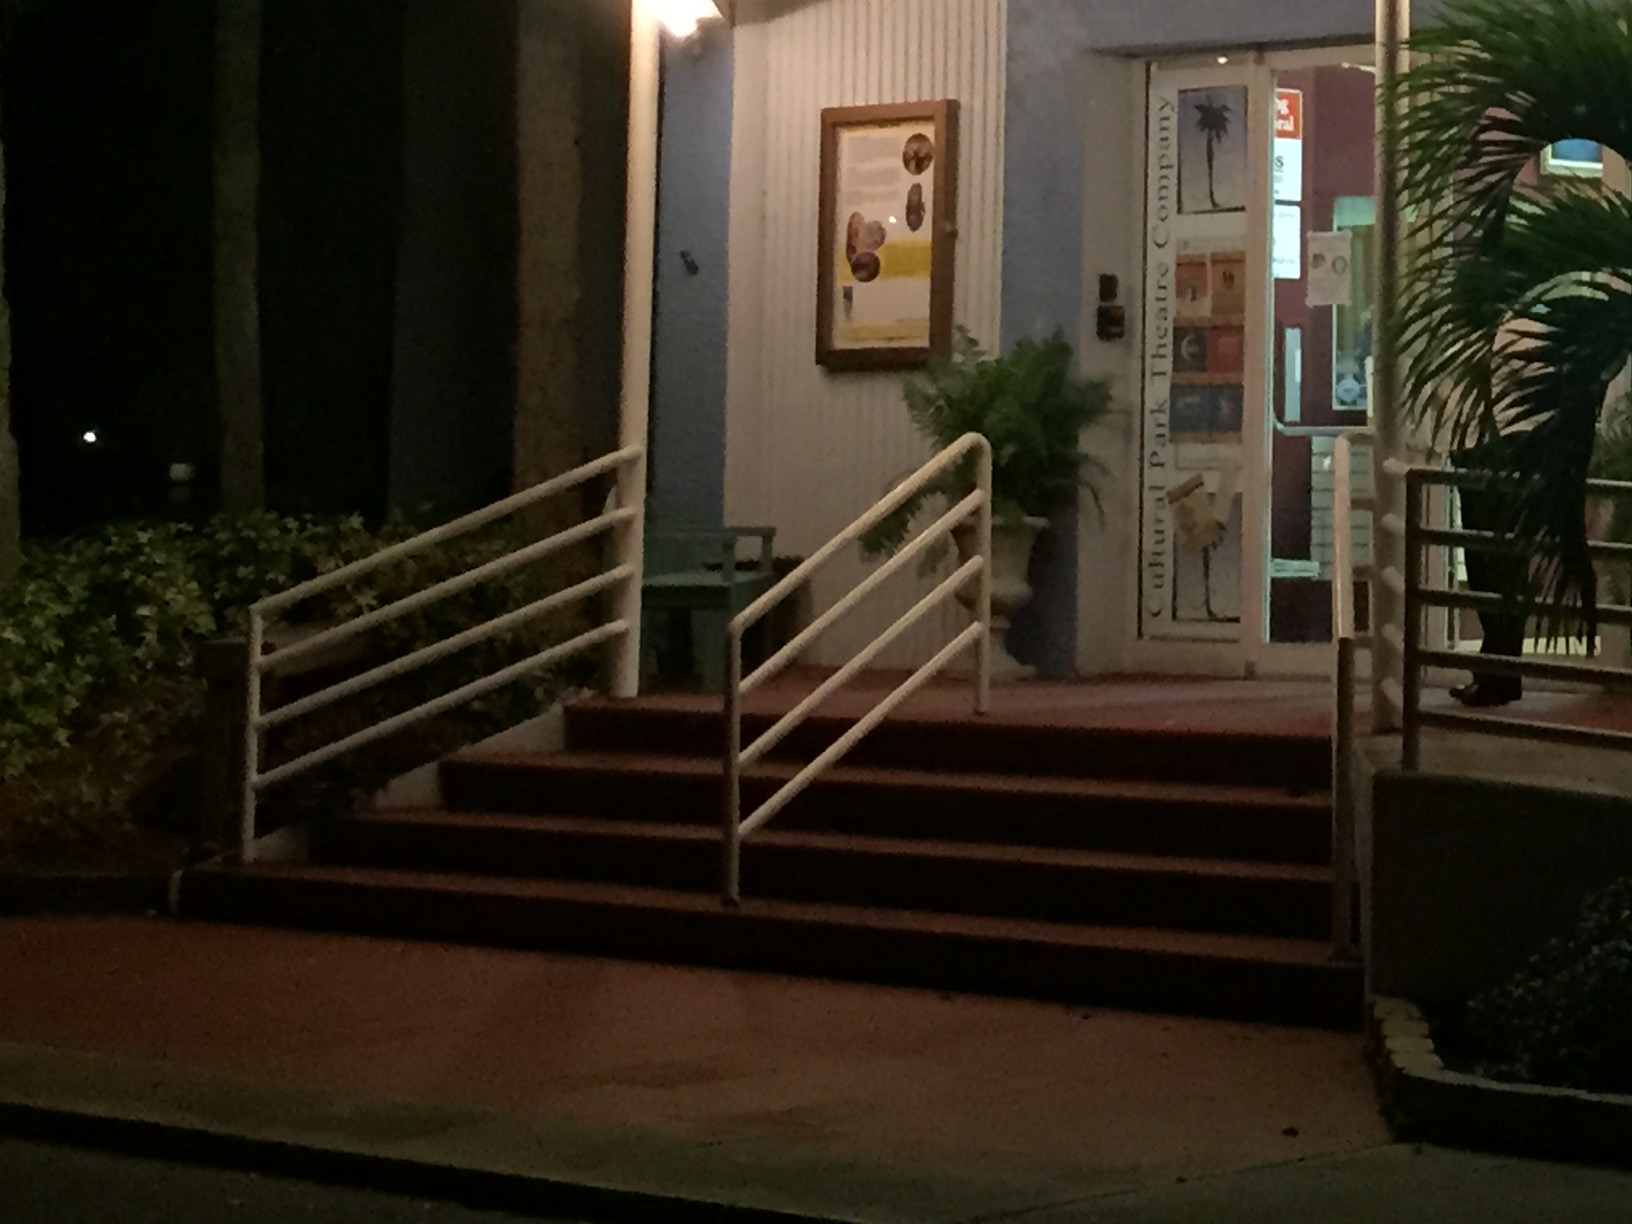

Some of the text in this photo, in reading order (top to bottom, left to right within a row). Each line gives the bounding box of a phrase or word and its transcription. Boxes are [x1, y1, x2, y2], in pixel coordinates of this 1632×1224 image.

[1148, 95, 1175, 620] Cultural Park Theatre Company
